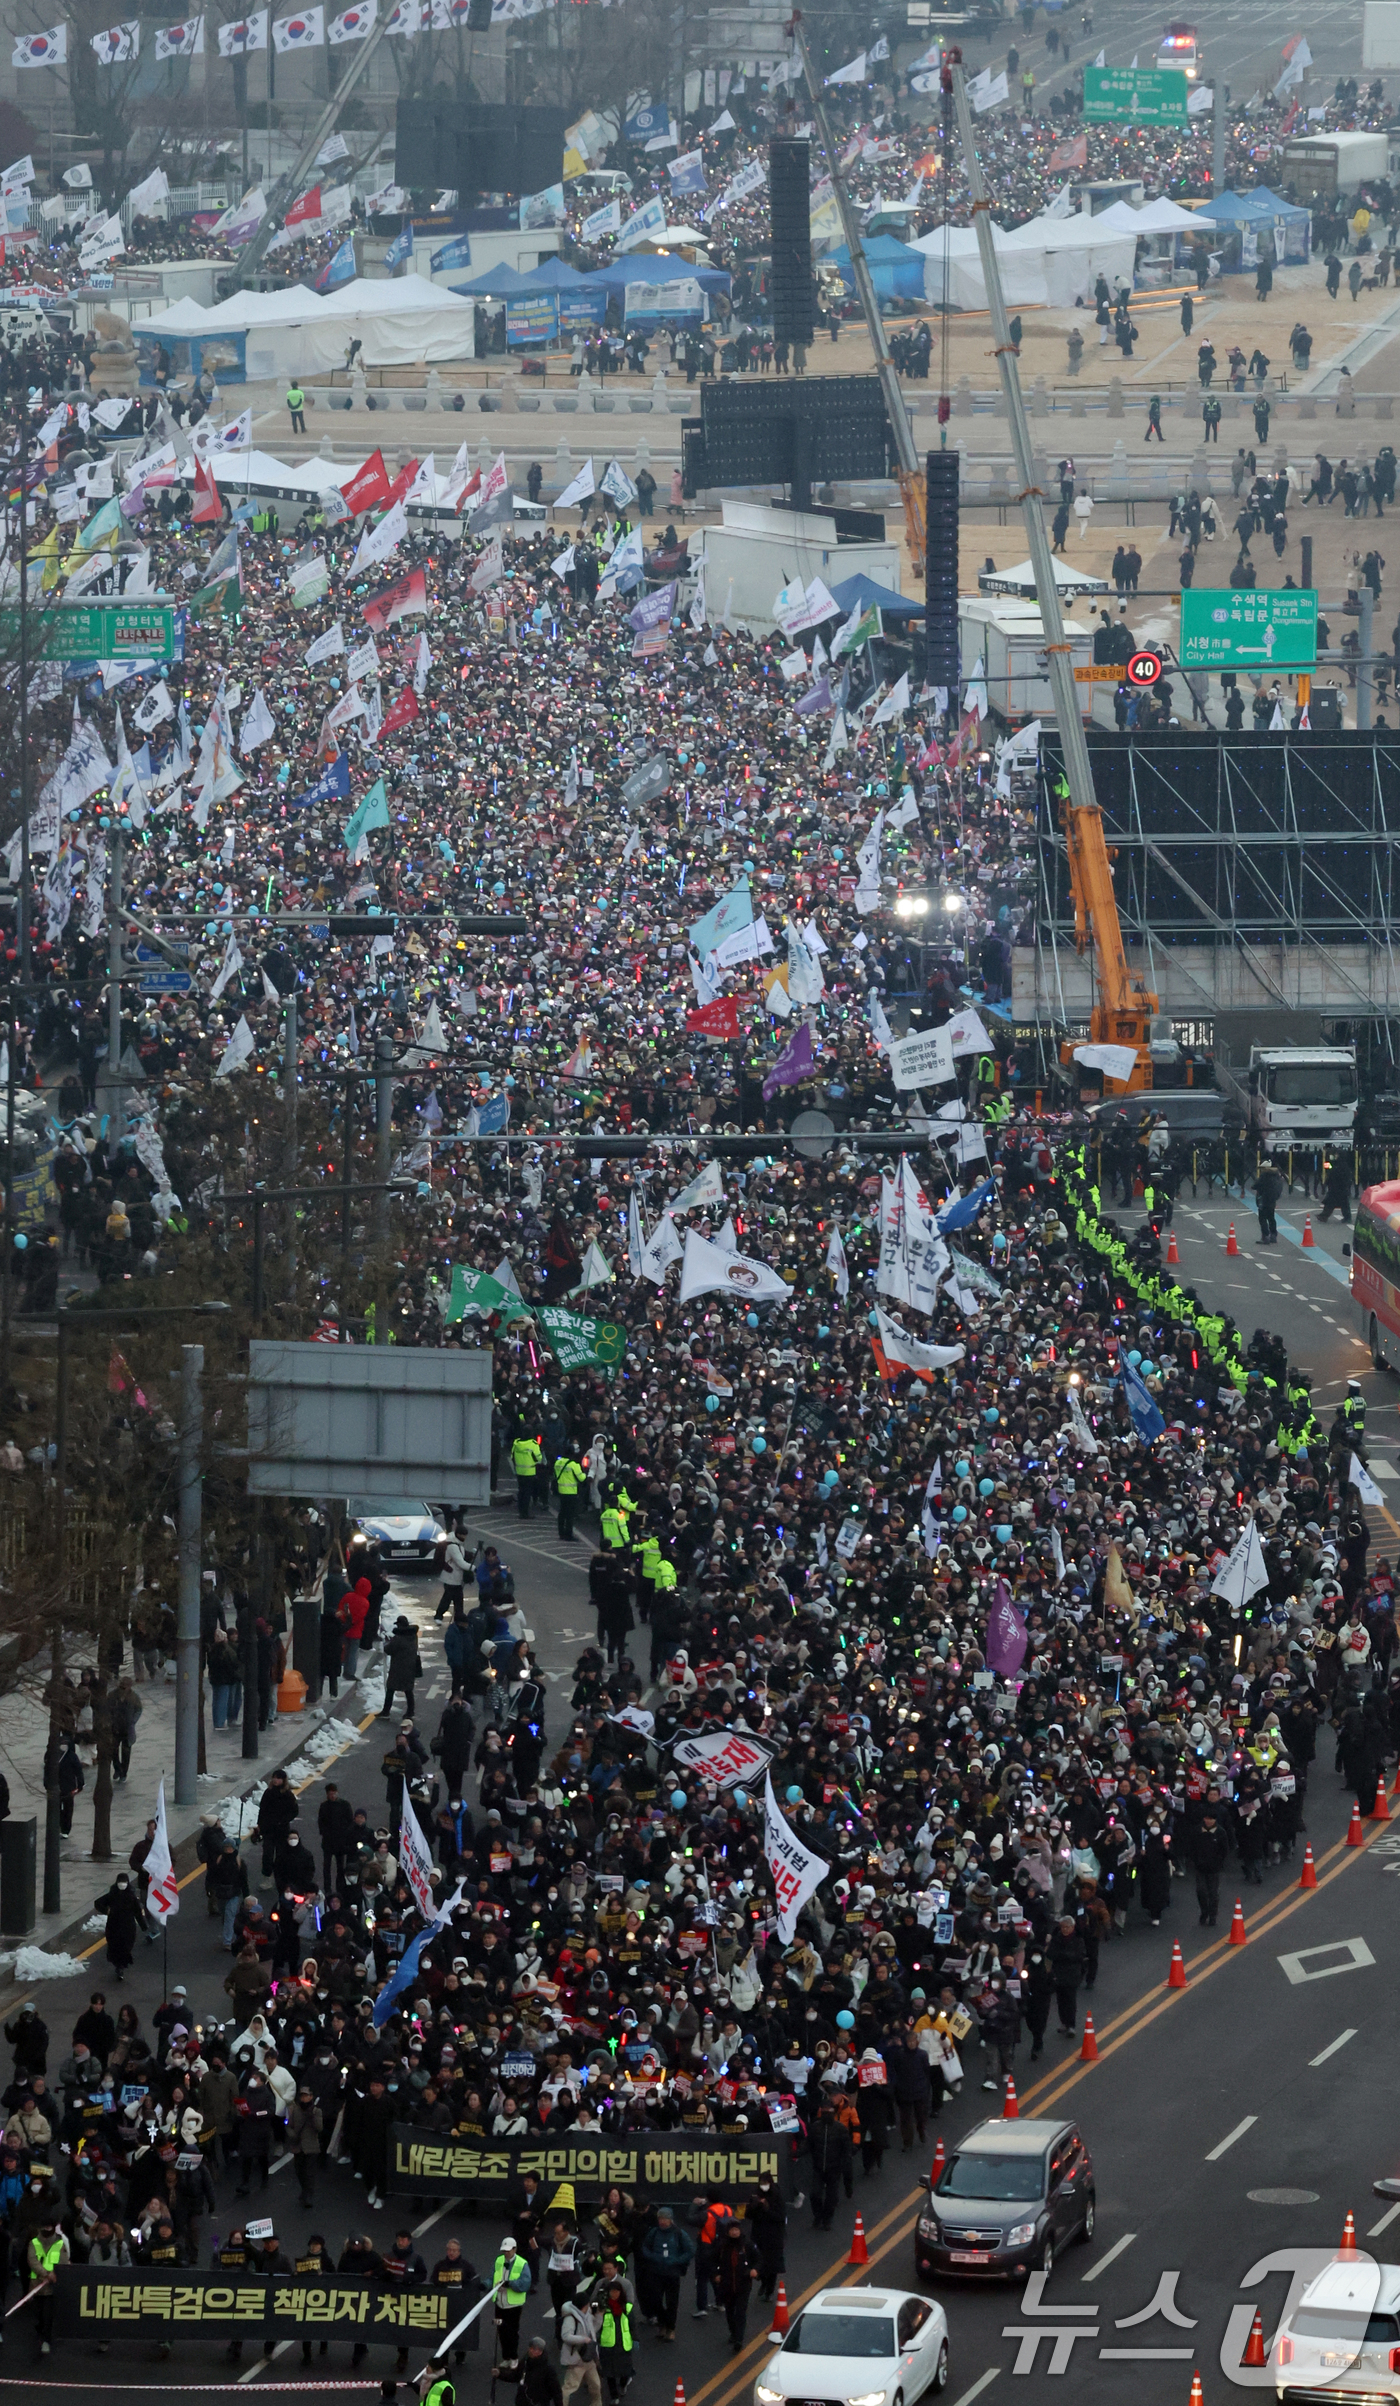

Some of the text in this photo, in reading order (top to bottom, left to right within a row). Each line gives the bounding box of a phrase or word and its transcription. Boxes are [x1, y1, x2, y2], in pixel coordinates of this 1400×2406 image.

[1231, 594, 1268, 607] 수색역
[1300, 598, 1313, 607] Stn
[115, 615, 164, 626] 삼청터널
[1215, 610, 1227, 620] 21
[1231, 609, 1269, 622] 독립문
[1186, 636, 1209, 649] 시청
[1186, 651, 1225, 661] City Hall
[1135, 661, 1154, 676] 40
[396, 2142, 779, 2184] 내란동조 국민의힘 해체하라!
[79, 2285, 448, 2330] 내란특검으로 책임자 처벌!
